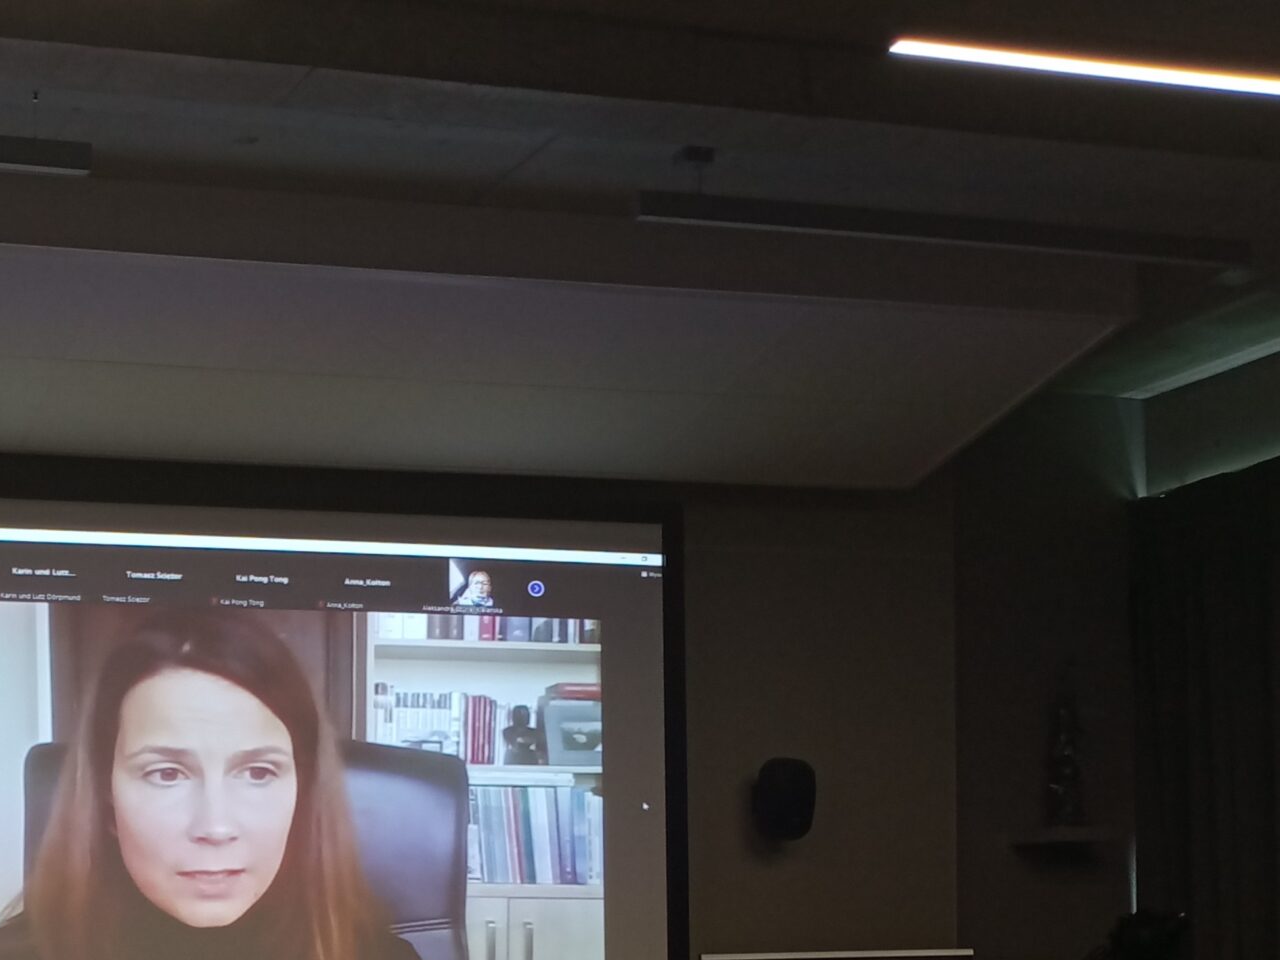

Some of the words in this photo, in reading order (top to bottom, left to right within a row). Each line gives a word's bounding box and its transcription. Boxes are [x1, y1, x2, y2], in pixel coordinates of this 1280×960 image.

[11, 566, 33, 576] Karin
[34, 568, 50, 577] und
[126, 570, 154, 579] Tomasz
[269, 575, 289, 585] Tong
